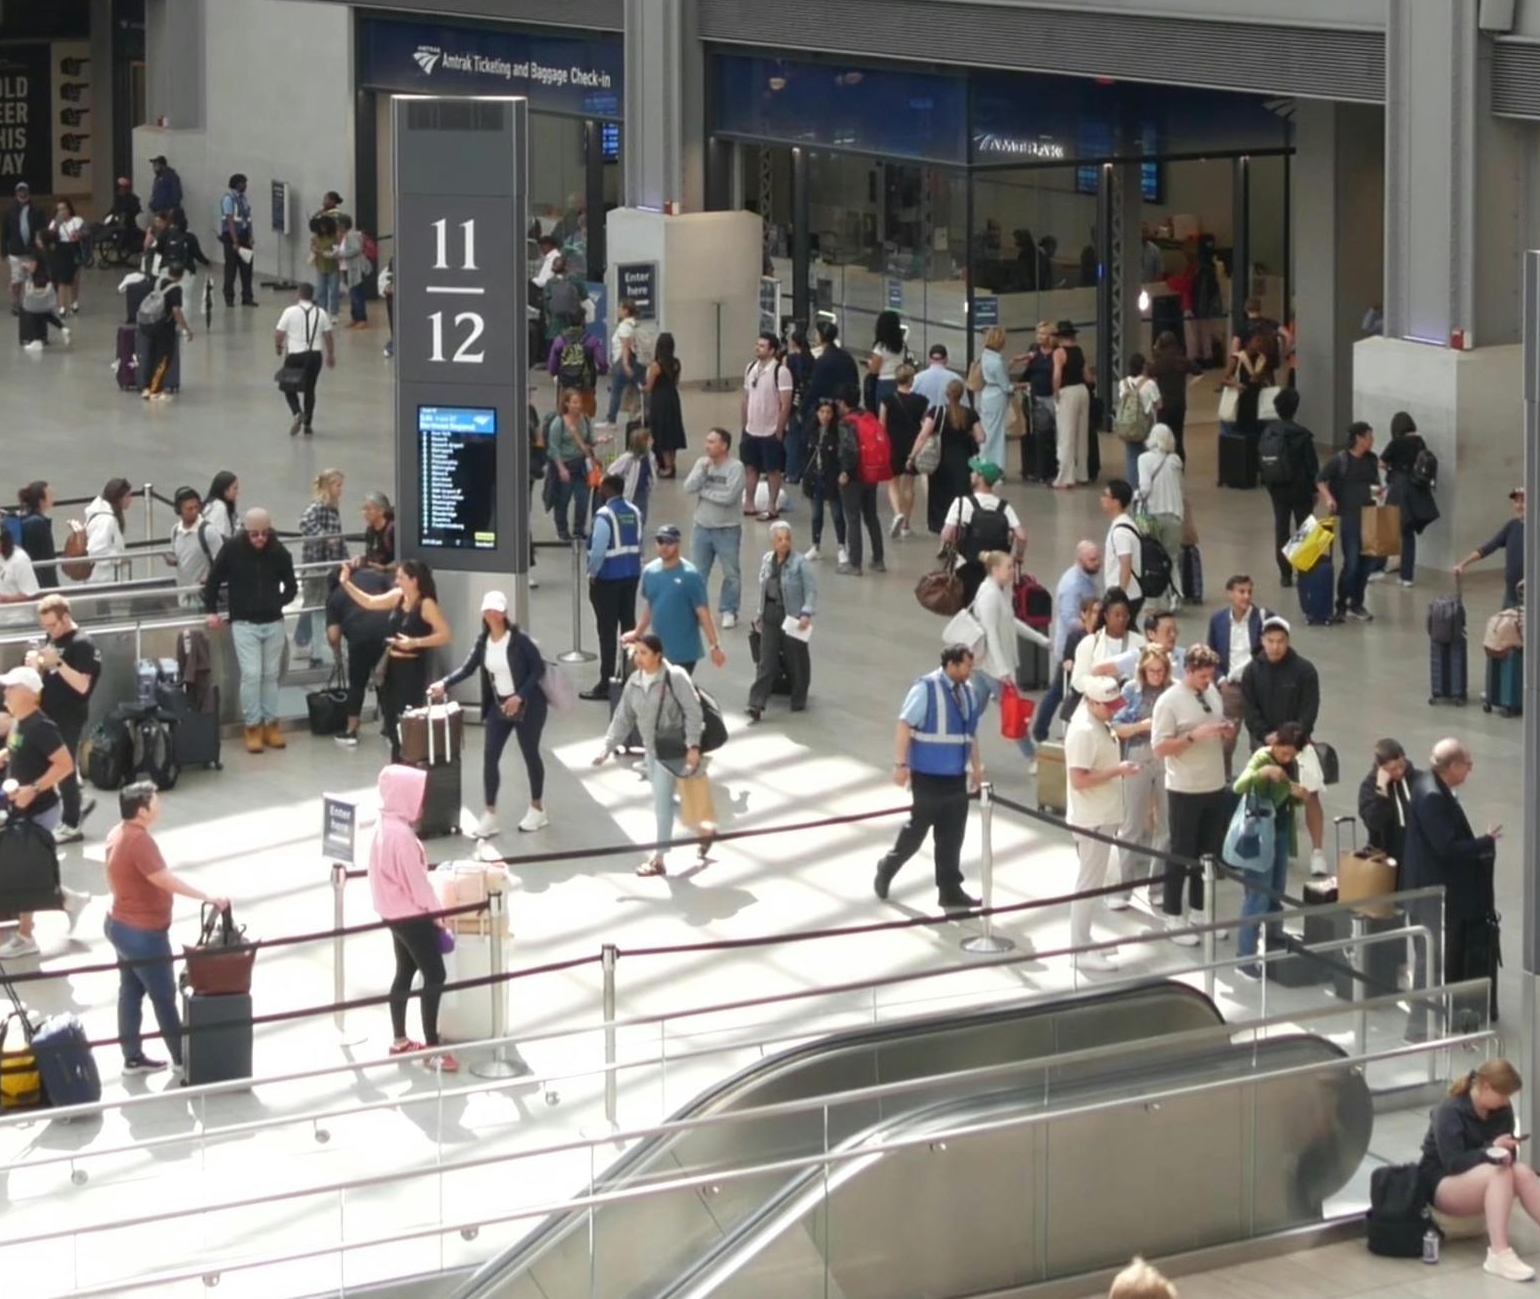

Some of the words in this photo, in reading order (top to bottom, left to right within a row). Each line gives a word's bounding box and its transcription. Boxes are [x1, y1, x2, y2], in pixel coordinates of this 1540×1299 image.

[442, 52, 473, 72] Amtrak
[475, 55, 511, 80] Ticketing
[513, 62, 528, 78] and
[531, 62, 568, 85] Baggage
[571, 67, 610, 88] Check-in
[435, 219, 475, 269] 11
[431, 312, 484, 362] 12
